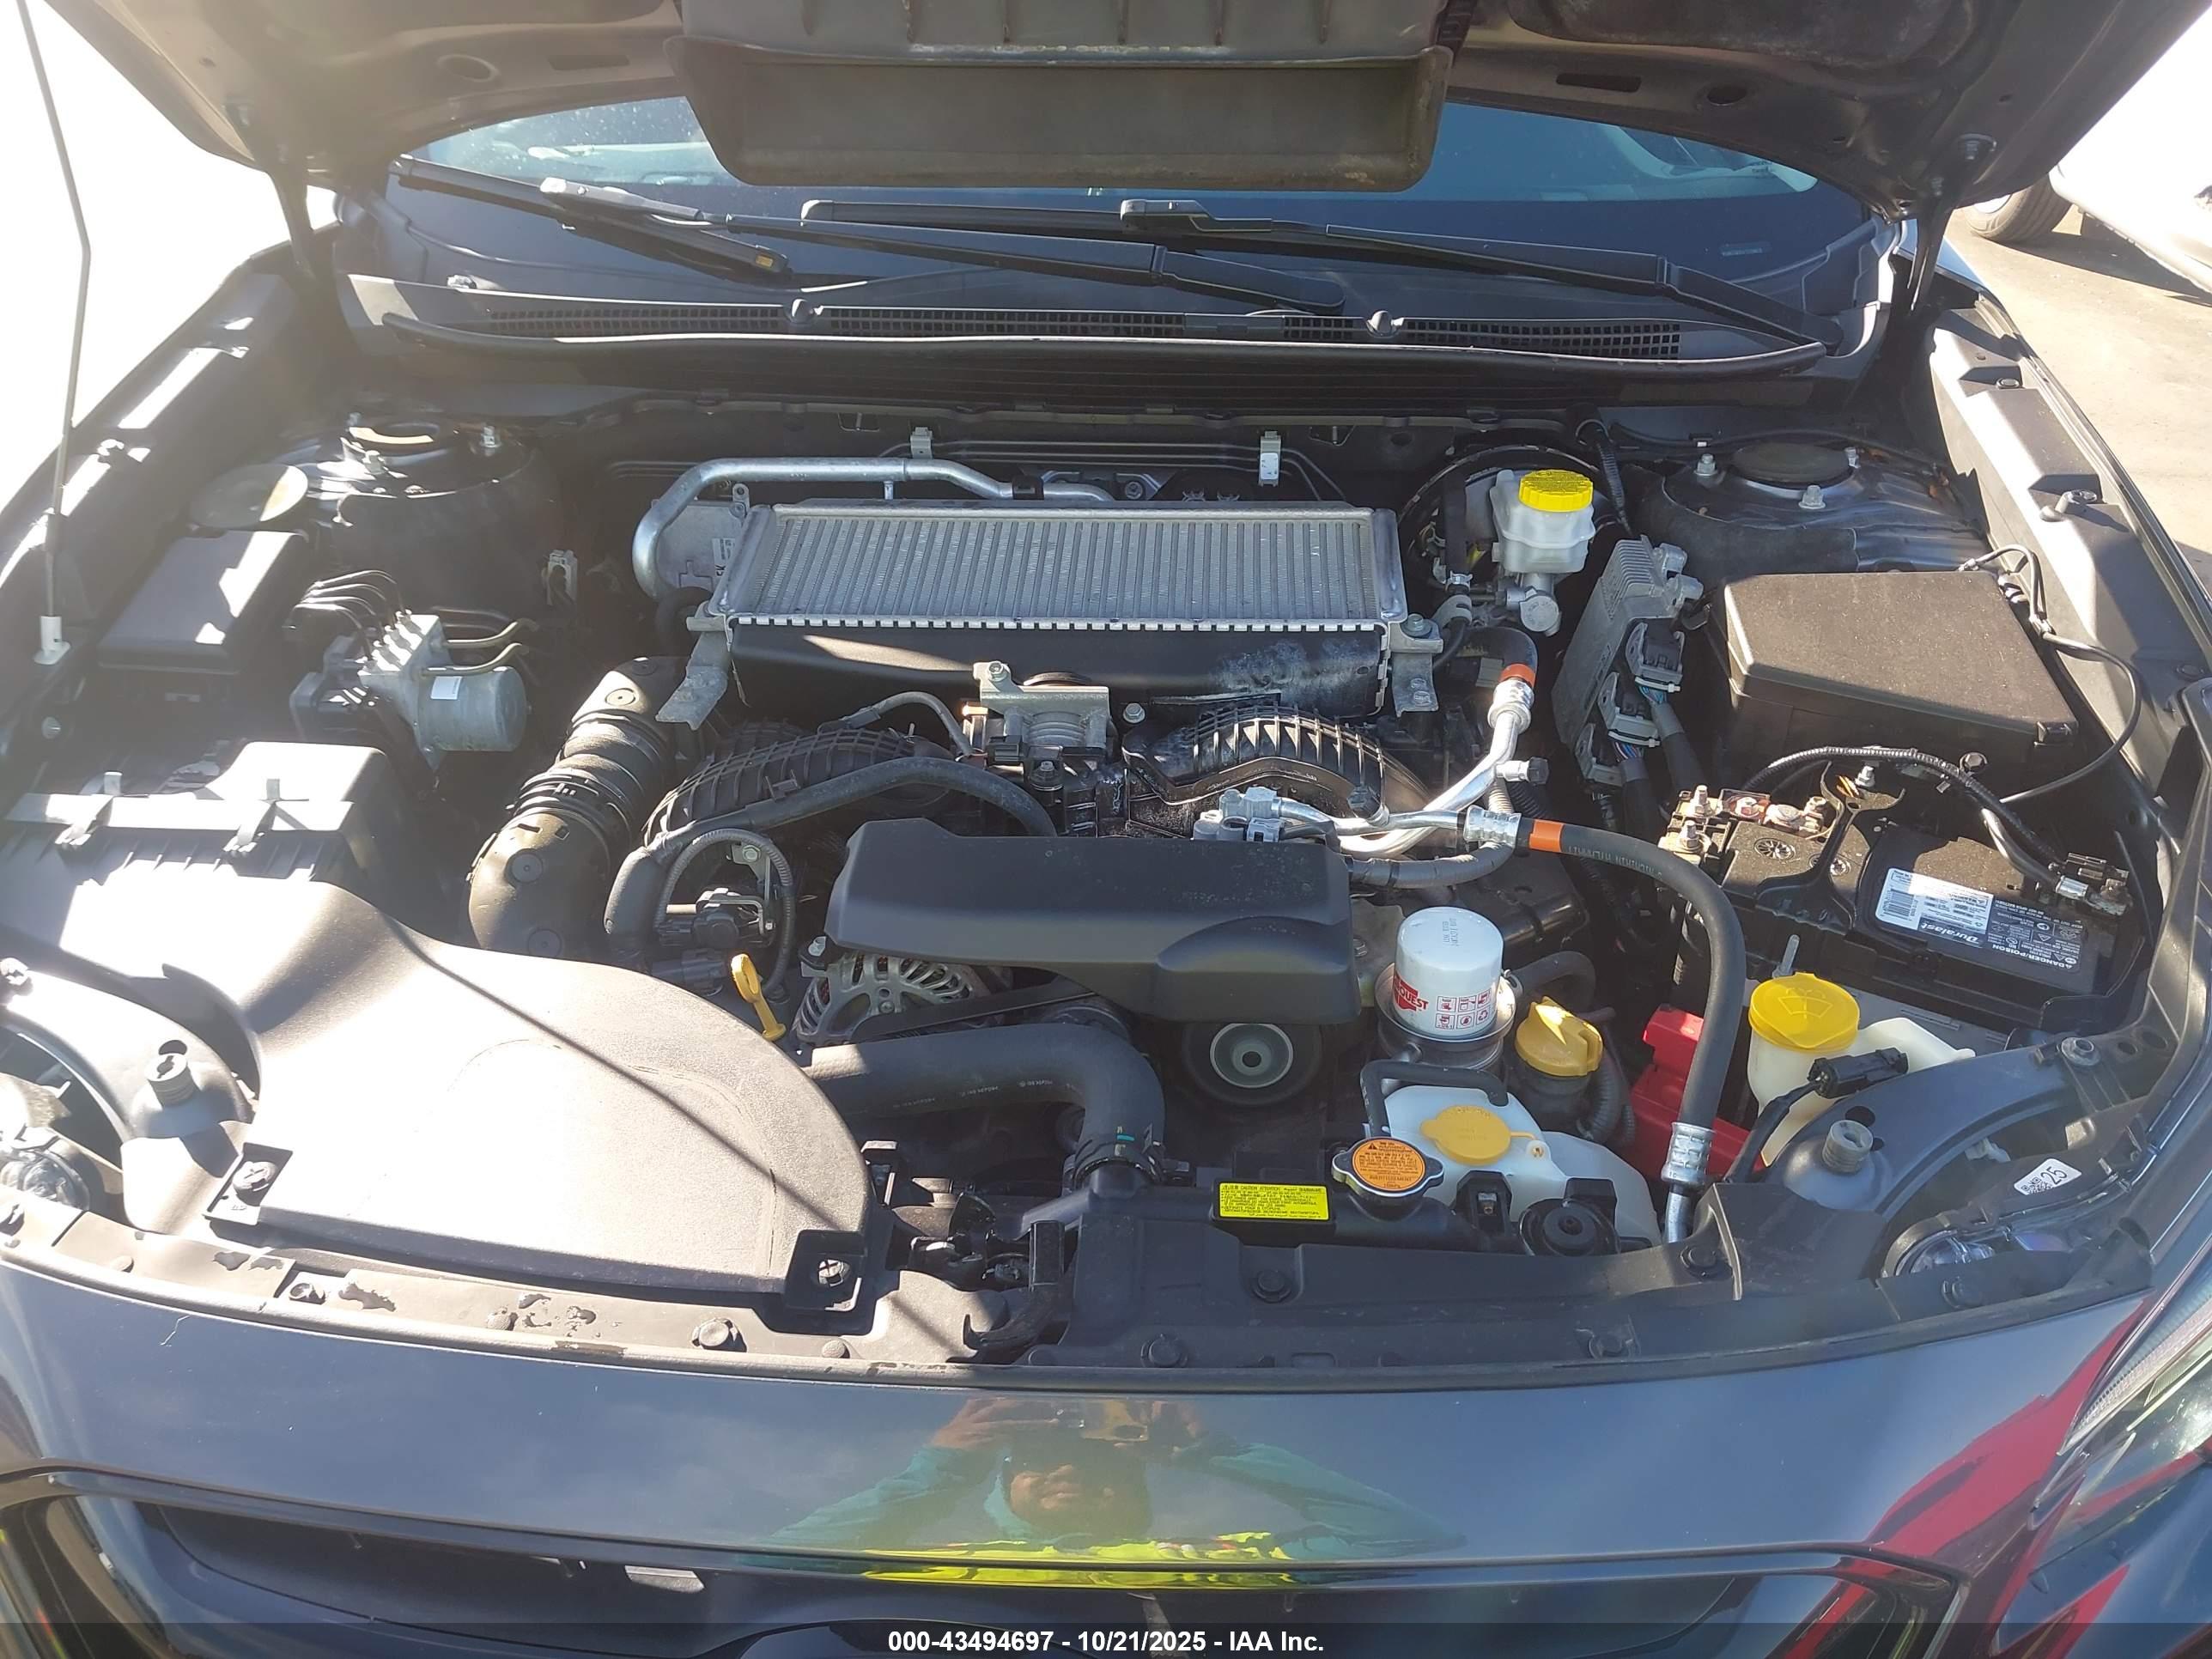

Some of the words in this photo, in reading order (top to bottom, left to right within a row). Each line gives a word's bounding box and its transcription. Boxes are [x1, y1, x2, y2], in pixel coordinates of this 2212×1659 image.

[1921, 922, 1979, 944] Duralast
[1992, 944, 2065, 968] DANGER/POISON
[2041, 1166, 2067, 1185] 25
